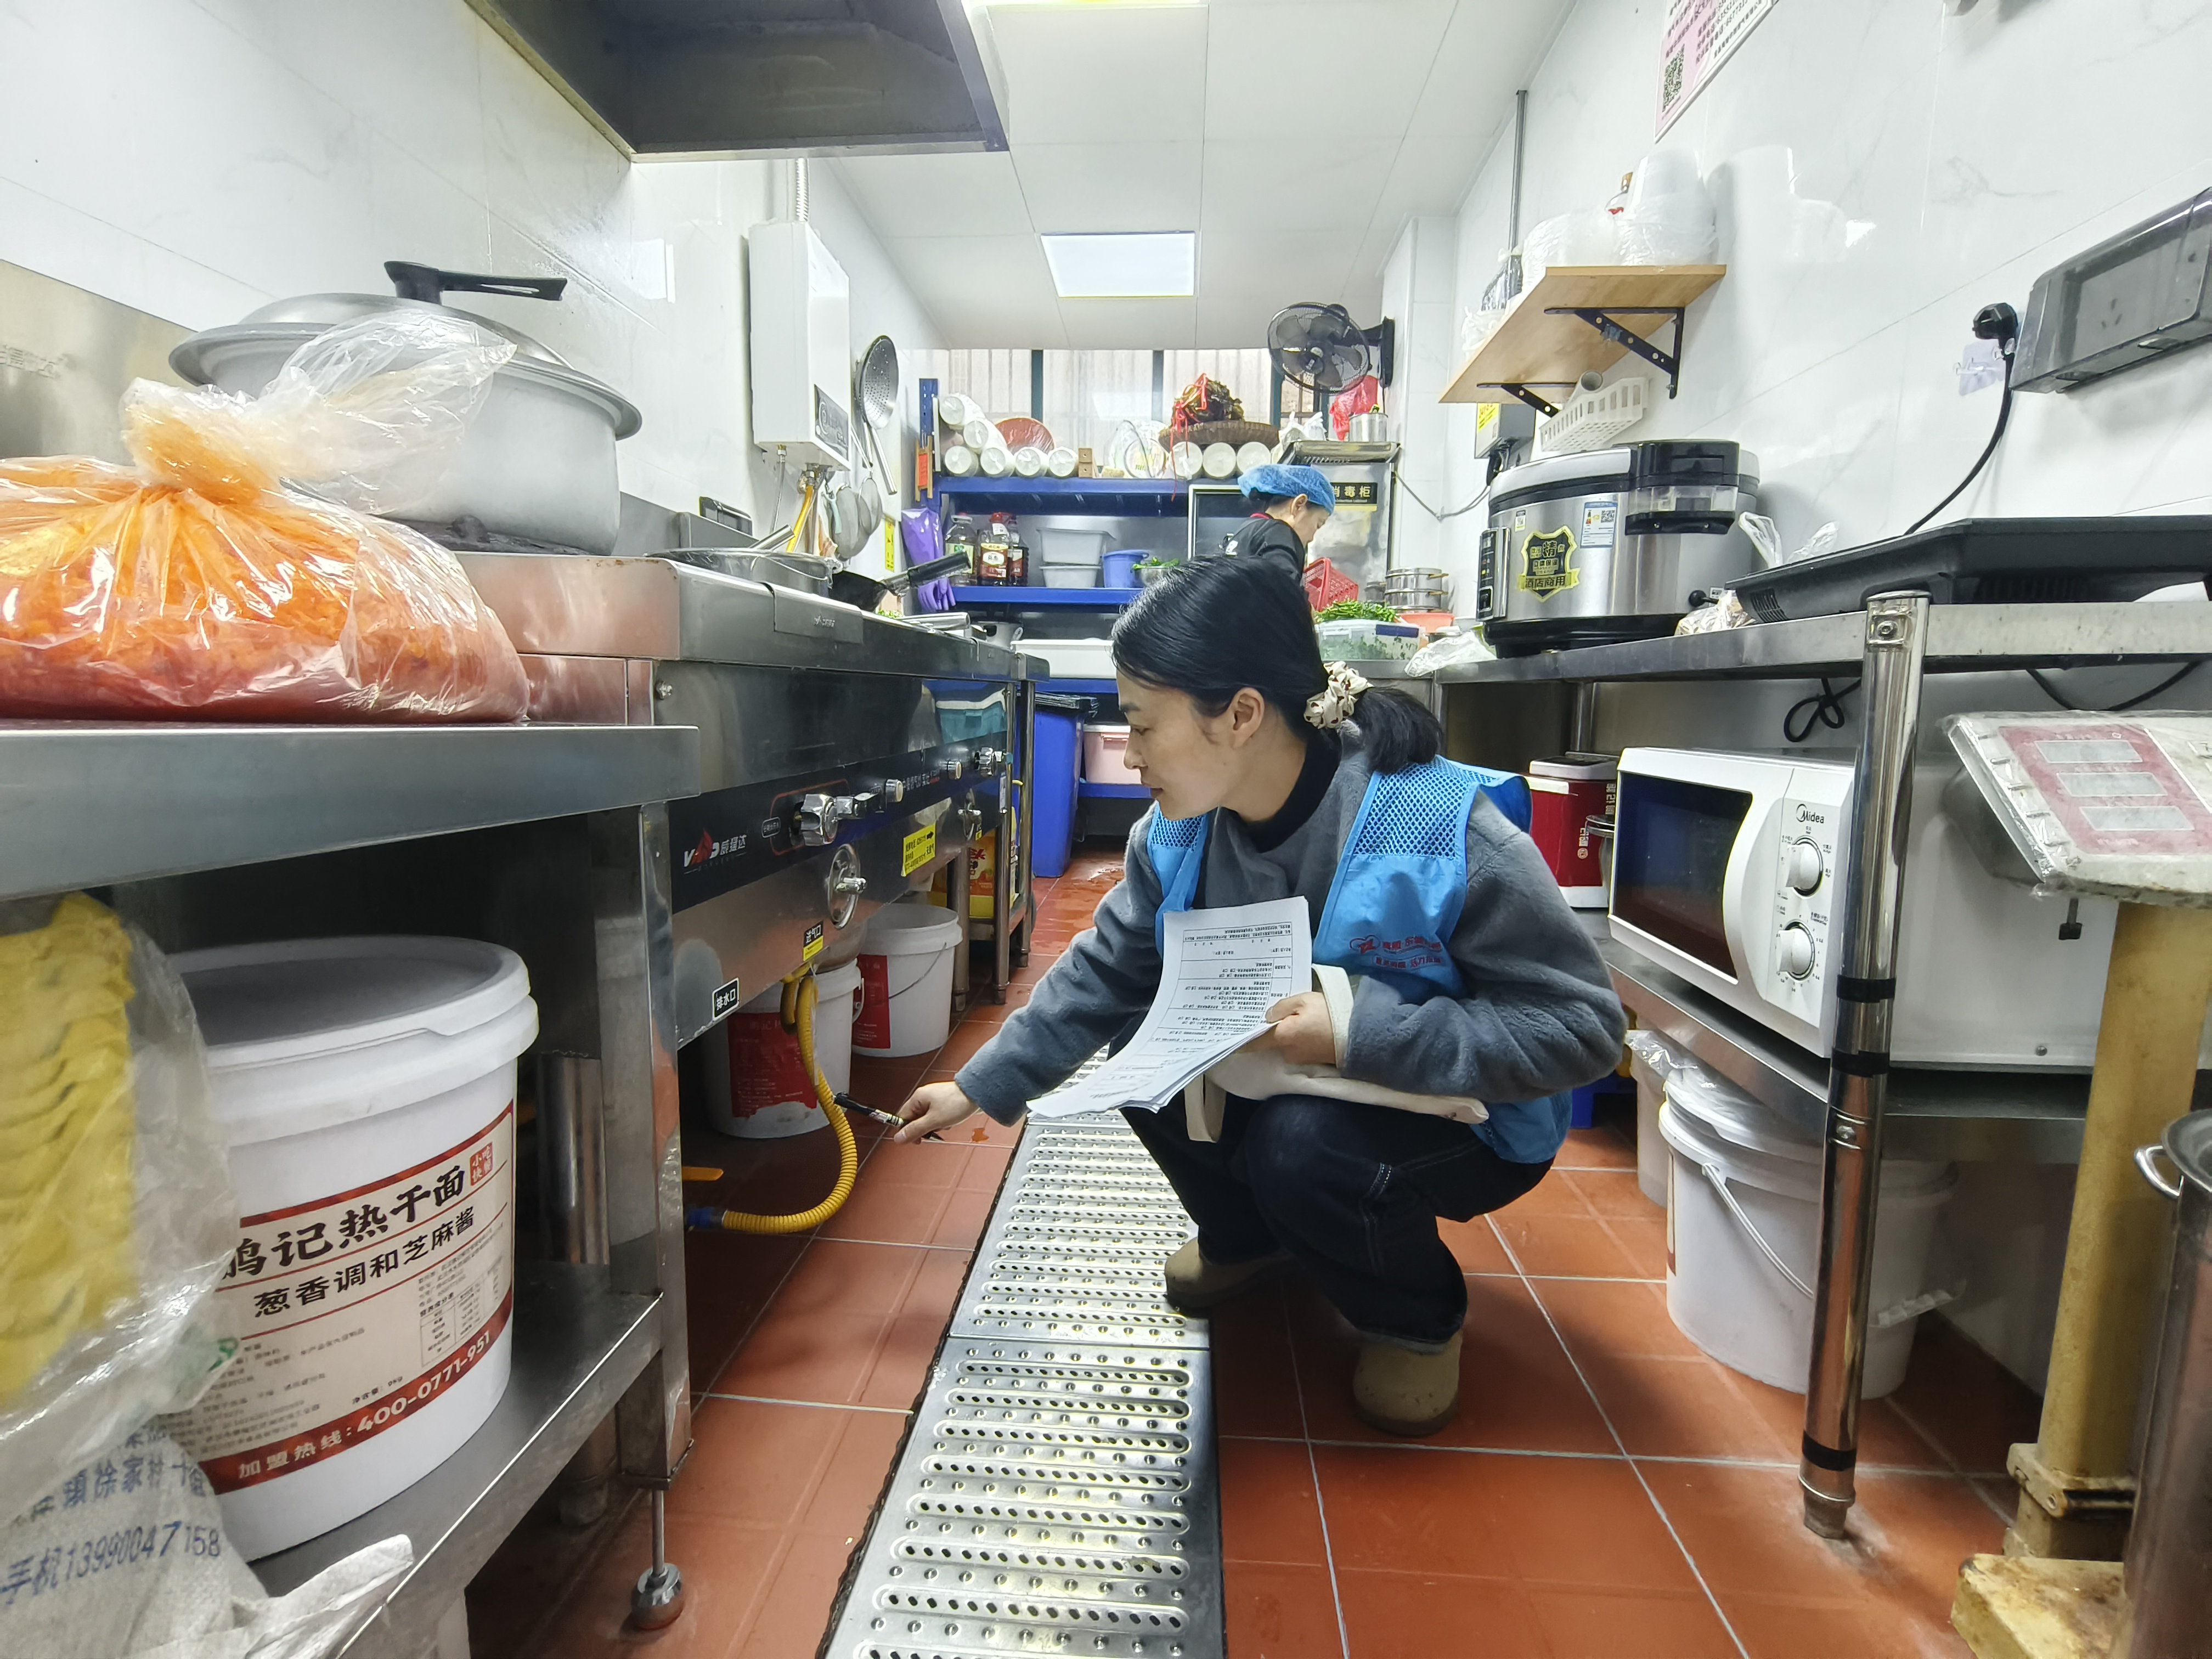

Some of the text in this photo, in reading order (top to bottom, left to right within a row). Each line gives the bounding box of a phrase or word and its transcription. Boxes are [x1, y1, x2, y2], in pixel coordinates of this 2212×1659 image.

[1796, 804, 1825, 823] Midea
[716, 989, 736, 1011] 排水口
[255, 1206, 475, 1318] 葱香调和芝麻酱
